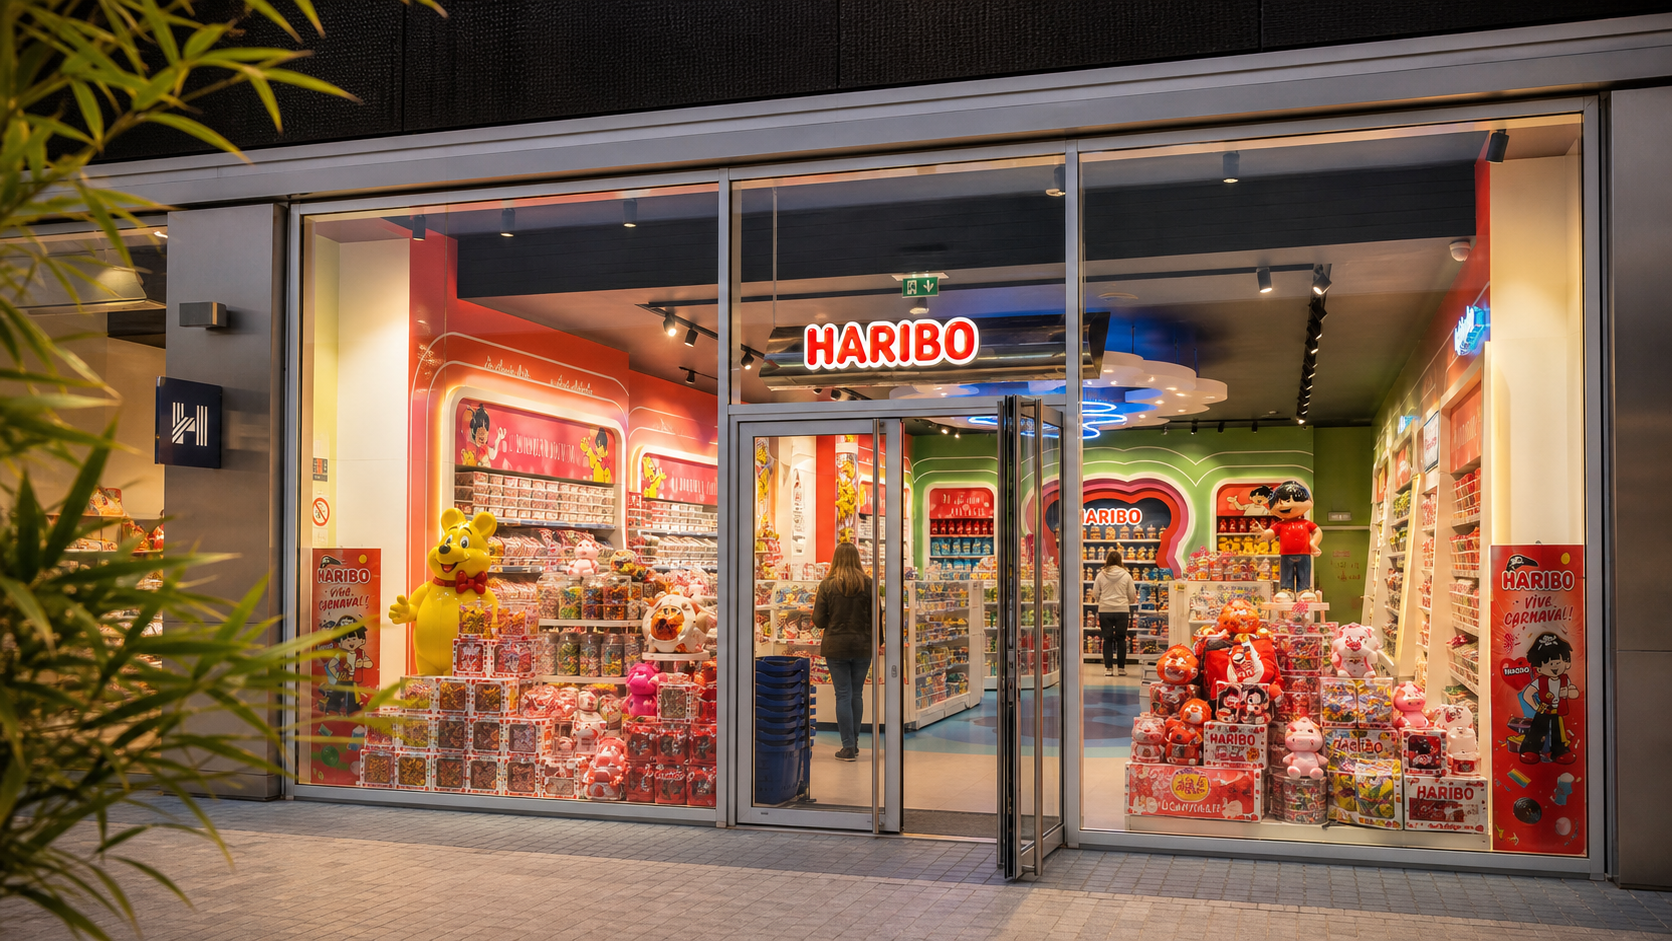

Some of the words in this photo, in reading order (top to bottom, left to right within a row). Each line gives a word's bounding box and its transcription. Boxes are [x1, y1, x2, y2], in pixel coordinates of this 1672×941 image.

[804, 316, 980, 371] HARIBO
[317, 568, 371, 584] HARIBO
[1501, 570, 1575, 591] HARIBO
[1210, 733, 1256, 746] HARIBO
[1417, 785, 1474, 801] HARIBO
